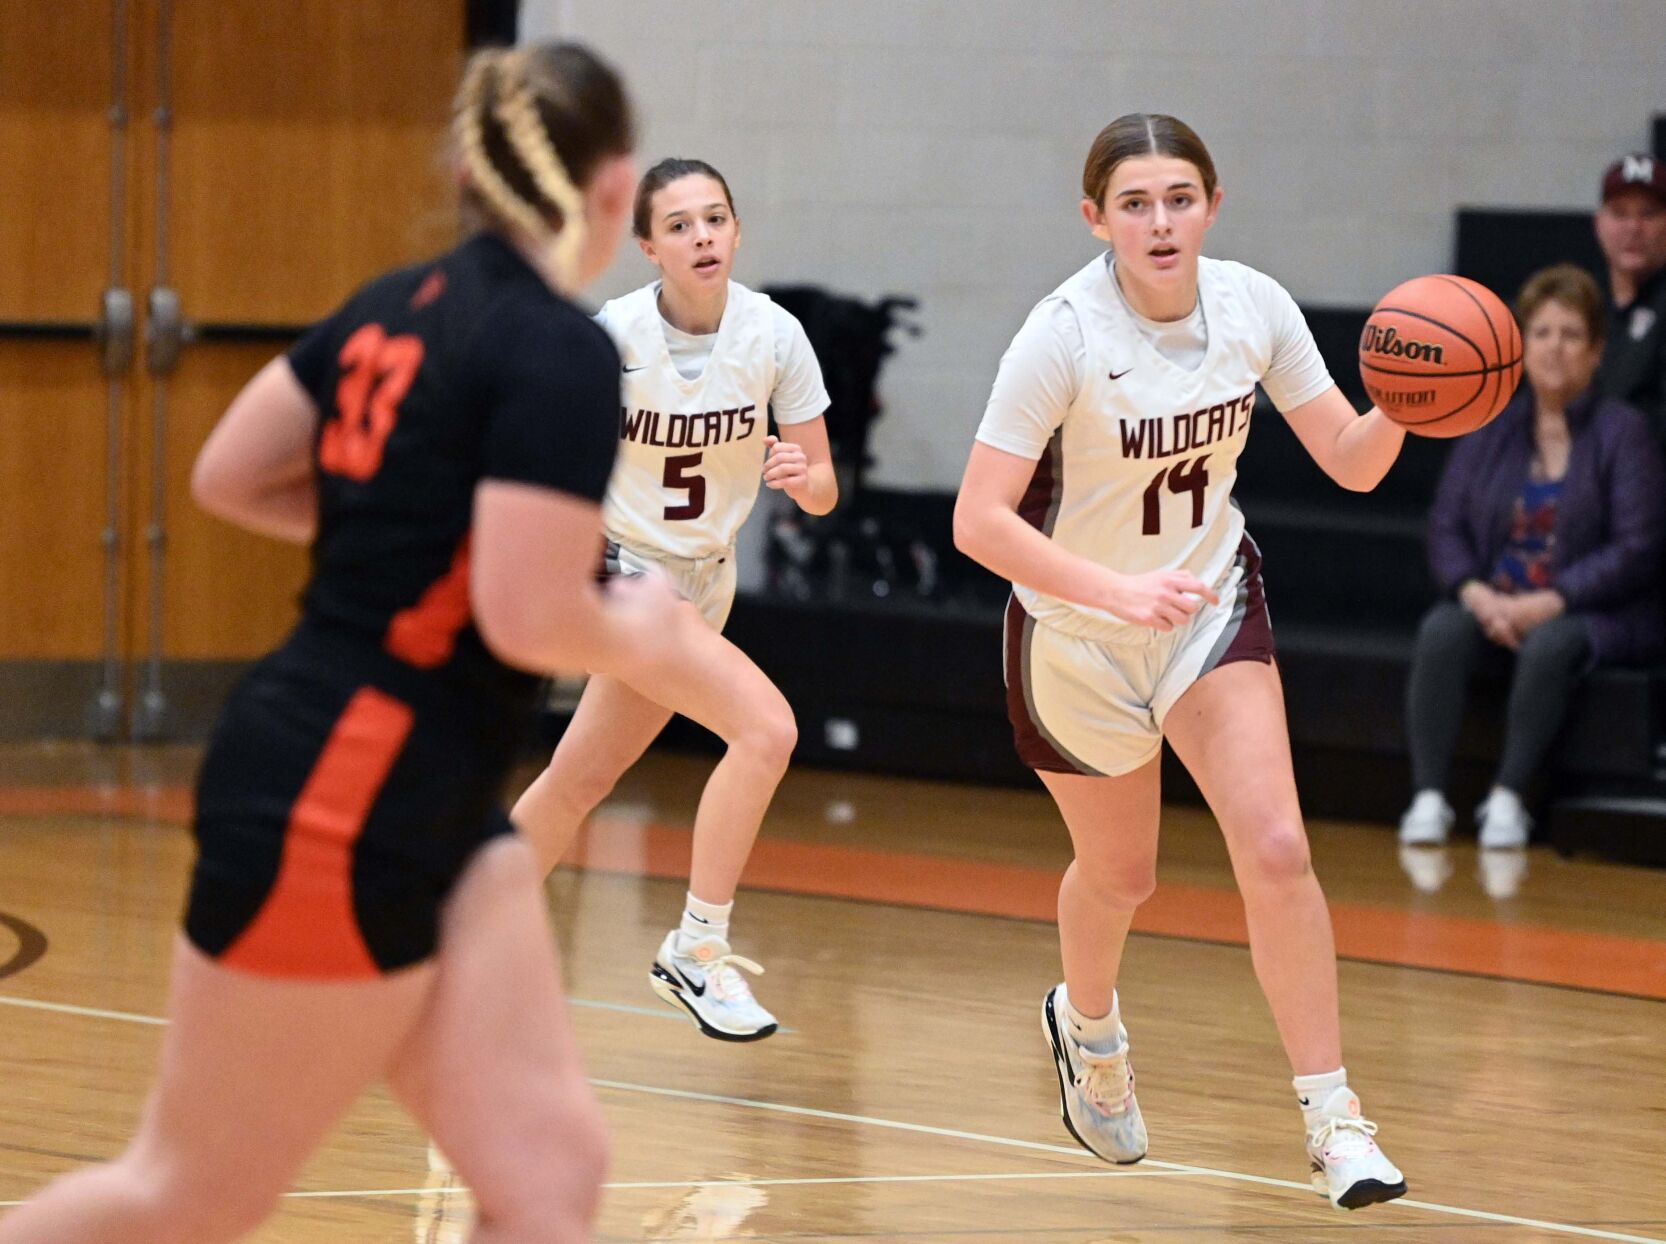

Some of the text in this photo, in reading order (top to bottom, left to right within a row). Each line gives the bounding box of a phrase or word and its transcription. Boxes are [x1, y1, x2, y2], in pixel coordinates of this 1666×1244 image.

[319, 322, 425, 482] 33
[620, 404, 756, 449] WILDCATS
[1119, 389, 1255, 460] WILDCATS
[662, 451, 706, 521] 5
[1142, 453, 1214, 536] 14
